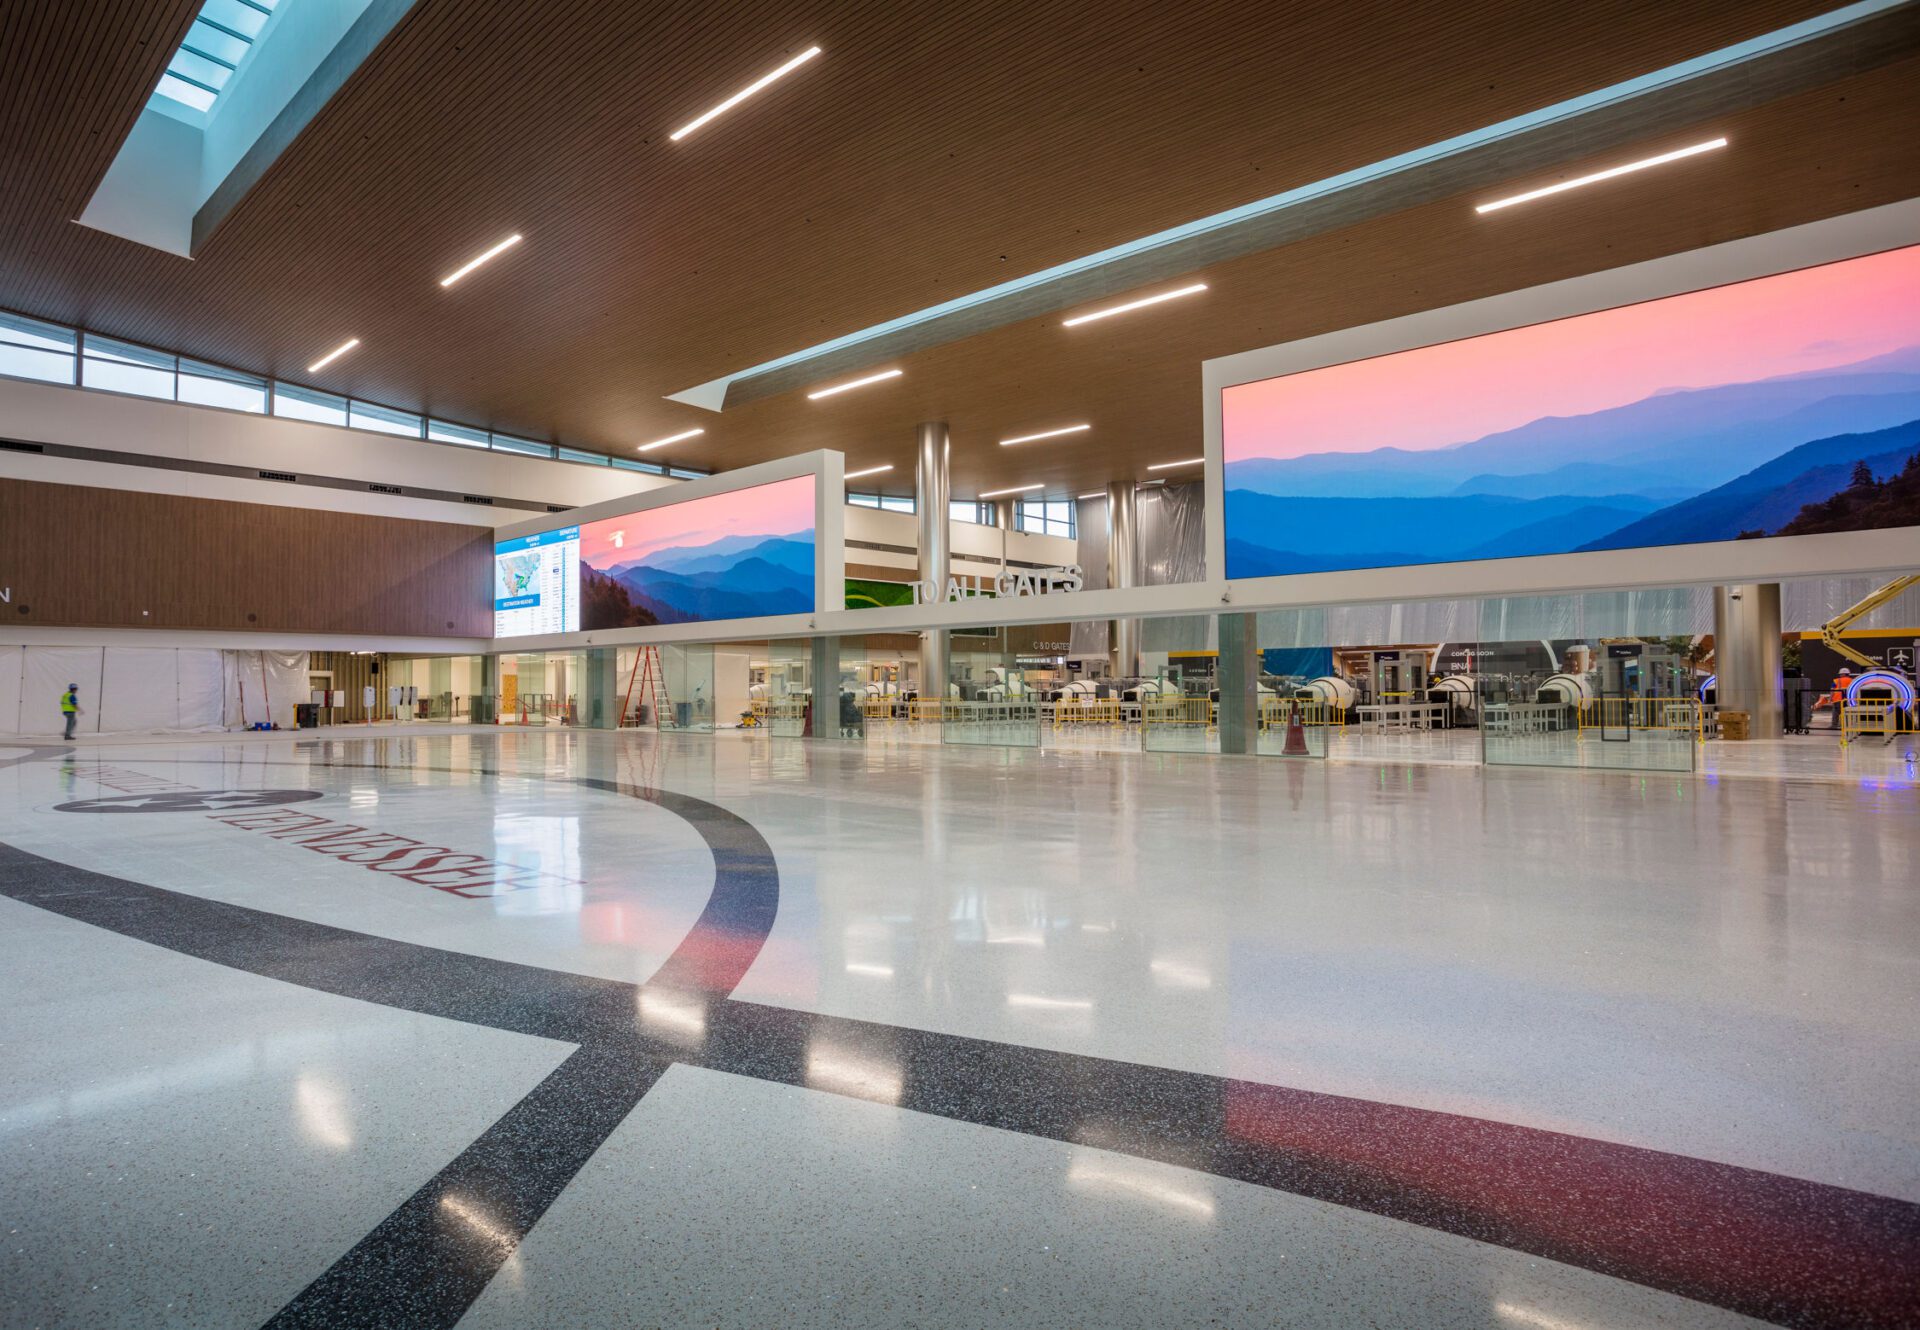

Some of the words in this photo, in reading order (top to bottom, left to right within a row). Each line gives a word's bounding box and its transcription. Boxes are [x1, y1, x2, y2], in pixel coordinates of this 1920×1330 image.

[908, 579, 939, 605] TO
[944, 576, 990, 603] ALL
[994, 564, 1083, 599] GATES
[1033, 641, 1039, 650] C
[1039, 641, 1044, 650] &
[1044, 641, 1050, 650] D
[1051, 641, 1071, 651] GATES
[206, 807, 588, 900] TENNESSEE
